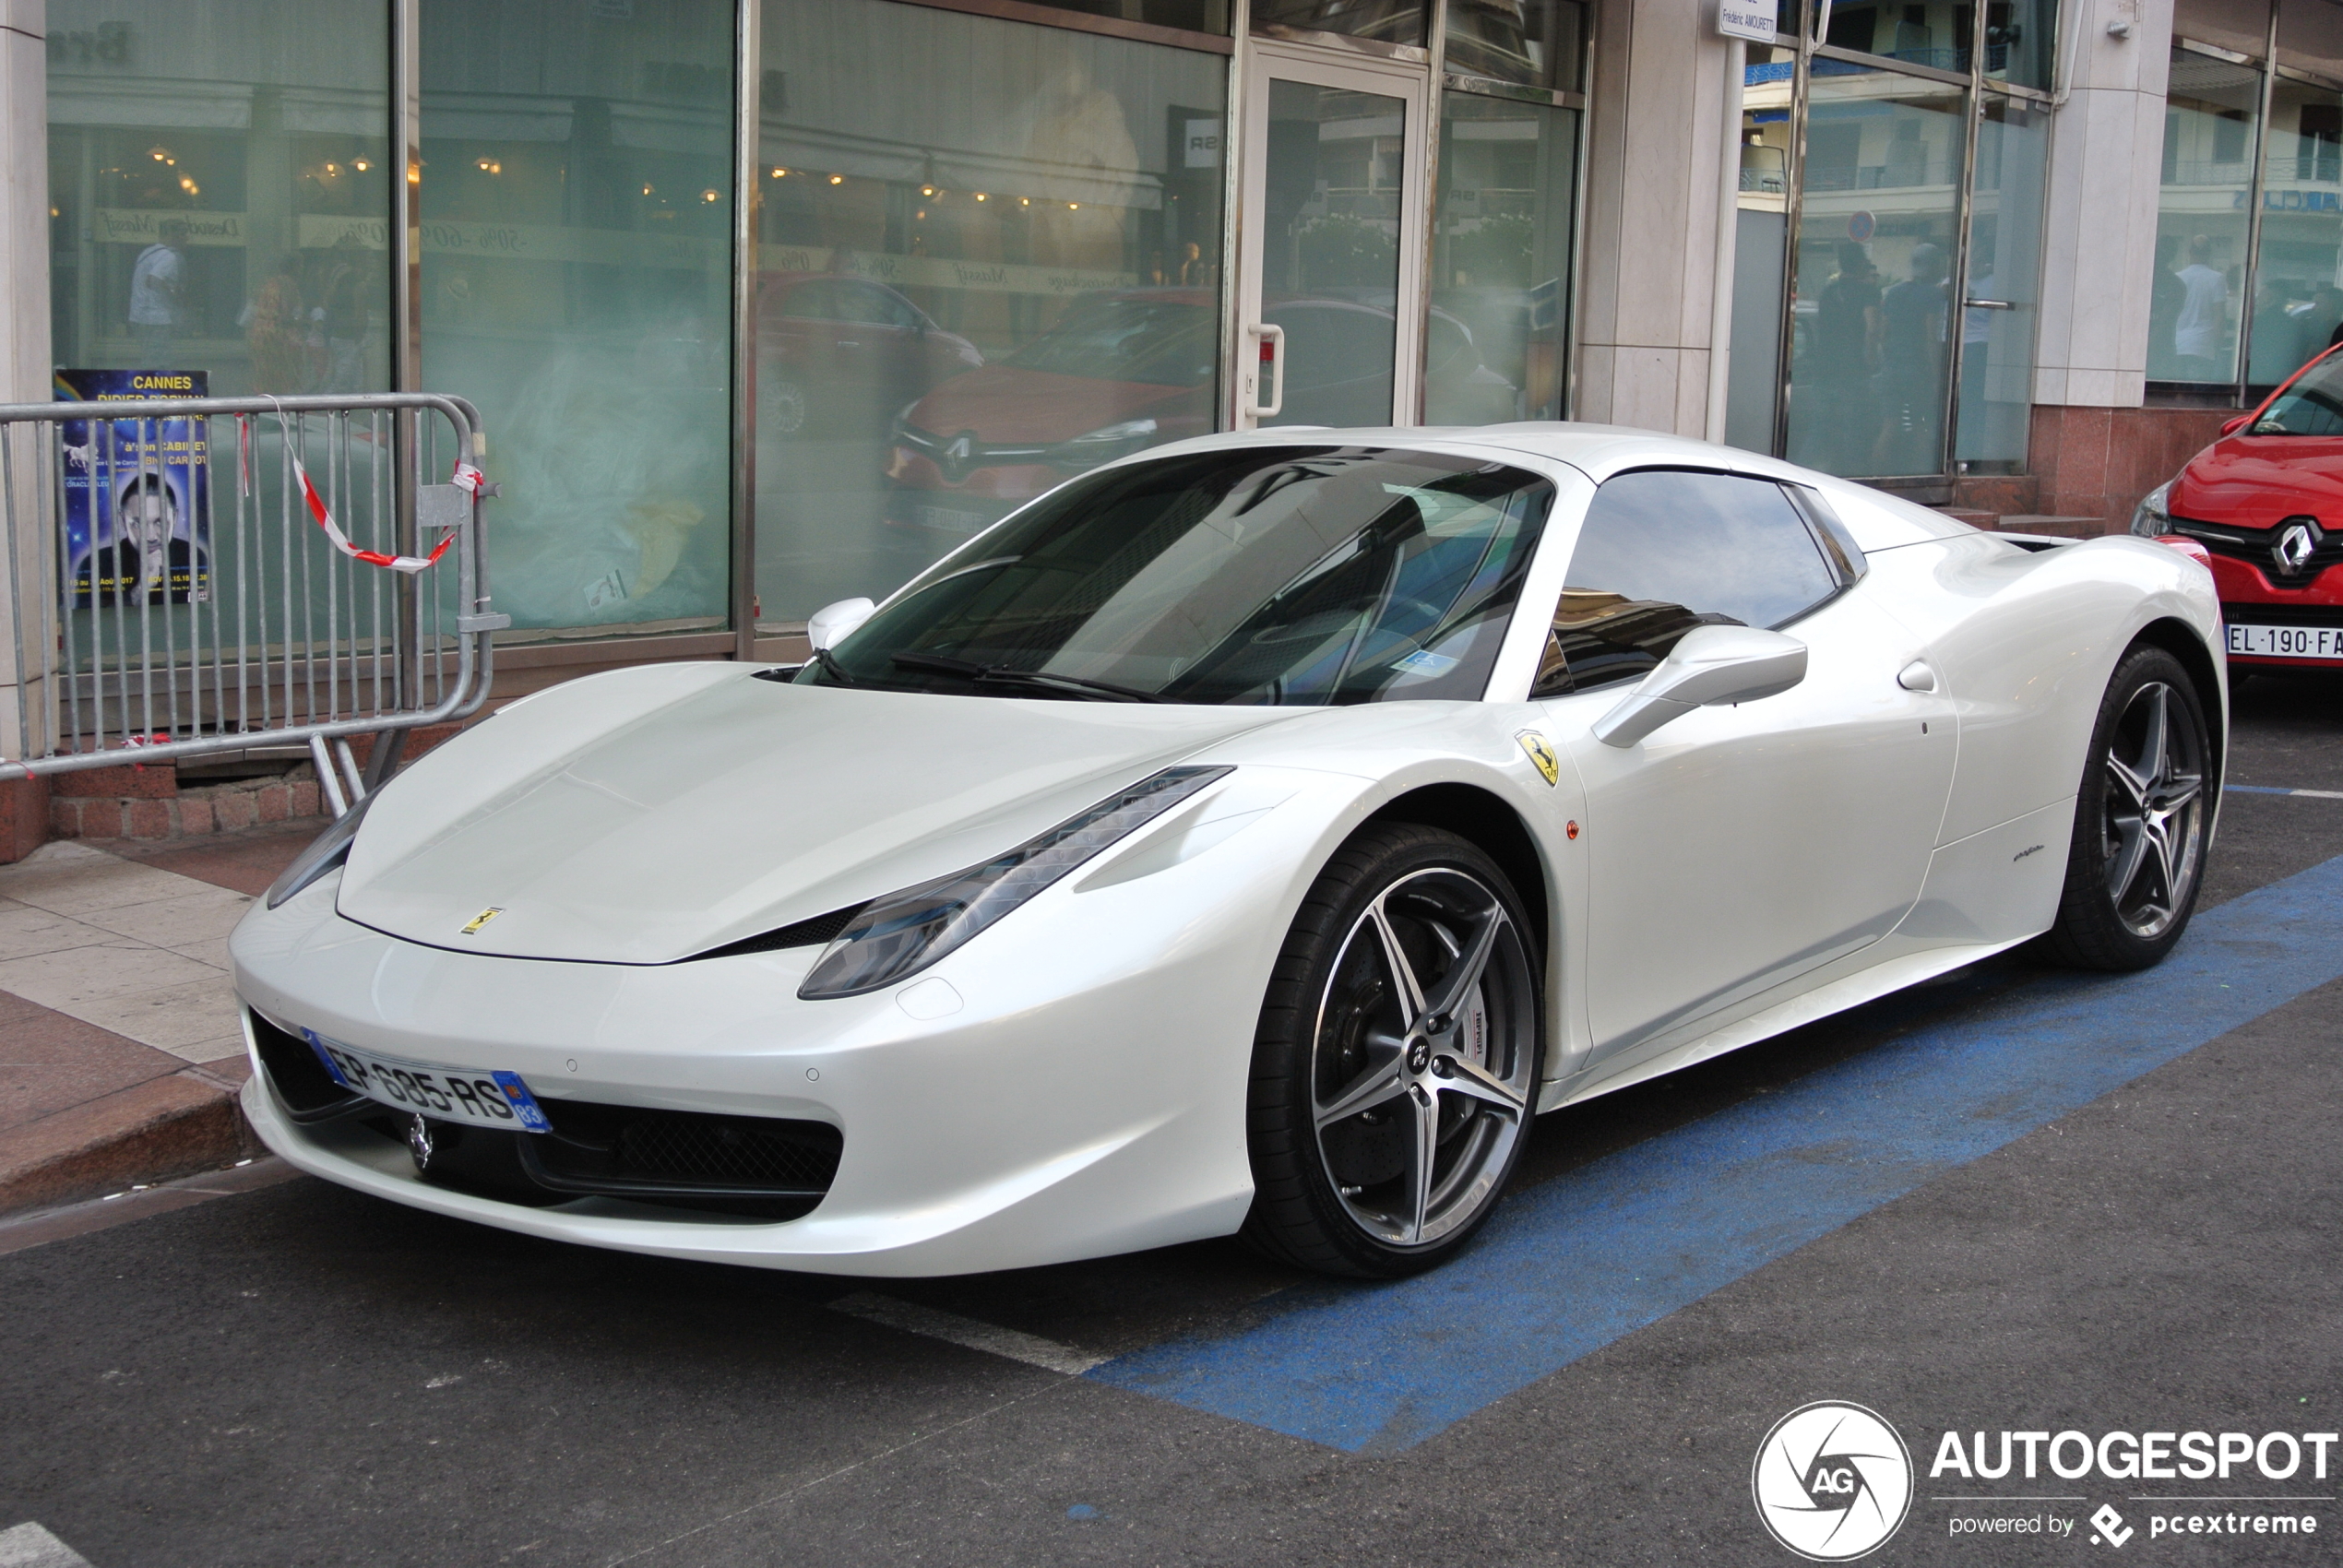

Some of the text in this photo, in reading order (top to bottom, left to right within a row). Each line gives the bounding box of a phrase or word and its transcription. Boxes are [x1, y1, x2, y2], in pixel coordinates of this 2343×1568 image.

[1723, 8, 1774, 32] Frédéric AMOURETTI
[133, 375, 192, 390] CANNES
